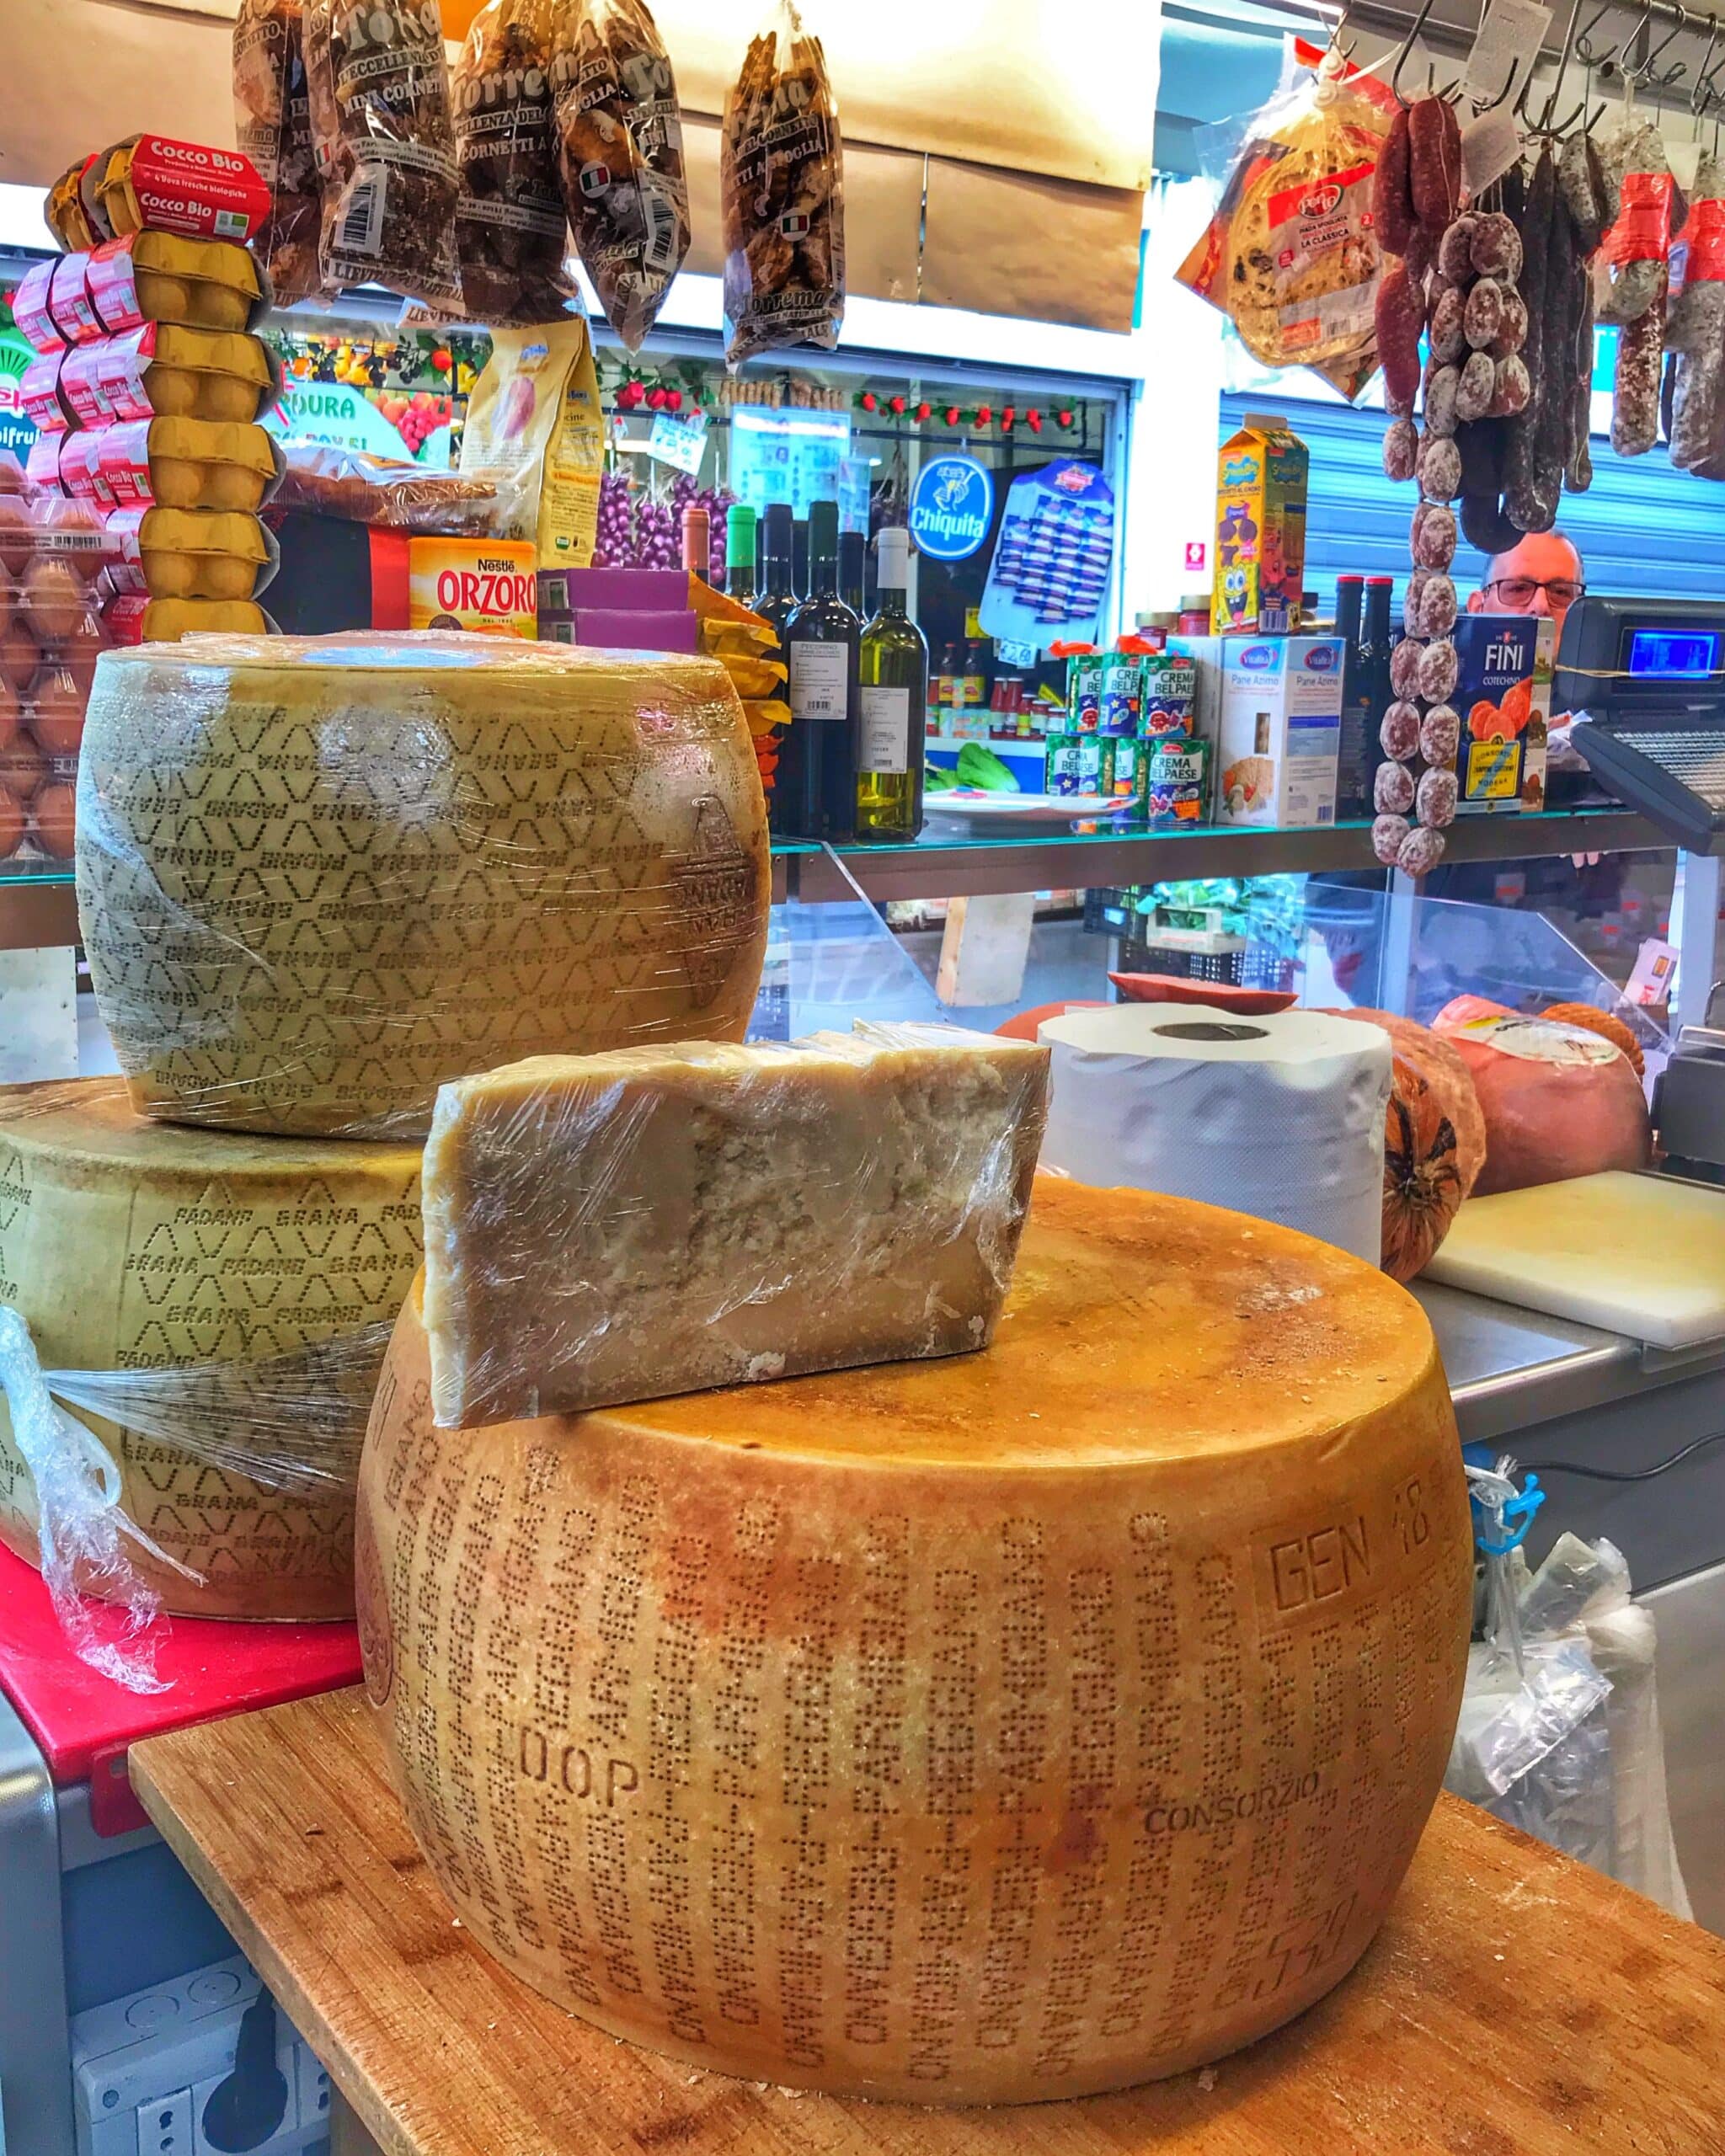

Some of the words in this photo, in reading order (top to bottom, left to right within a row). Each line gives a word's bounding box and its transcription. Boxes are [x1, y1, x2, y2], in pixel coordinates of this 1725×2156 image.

[150, 141, 208, 165] Cocco
[211, 152, 244, 173] Bio
[462, 137, 534, 163] CORNETTI
[517, 106, 544, 125] DEL
[140, 192, 184, 212] Cocco
[187, 200, 212, 218] Bio
[181, 178, 208, 192] fresche
[209, 184, 248, 200] biologiche
[1300, 239, 1311, 248] LA
[1311, 228, 1350, 246] CLASSICA
[911, 506, 985, 542] Chiquita
[437, 569, 537, 616] ORZORO
[1117, 669, 1139, 682] CRE
[1231, 675, 1252, 685] Pane
[1253, 675, 1279, 686] Azimo
[1296, 676, 1316, 686] Pane
[1317, 676, 1338, 686] Azimo
[1484, 644, 1524, 671] FINI
[1152, 757, 1191, 769] CREMA
[154, 847, 235, 867] GRANA
[275, 1207, 359, 1226] GRANA
[328, 1252, 414, 1273] GRANA
[166, 1305, 250, 1325] GRANA
[273, 1305, 363, 1325] PADANO
[175, 1492, 259, 1511] GRANA
[447, 1474, 505, 1705] REGGIANO
[1269, 1515, 1372, 1613] GEN
[649, 1535, 711, 1785] REGGIANO
[783, 1556, 841, 1808] REGGIANO
[852, 1512, 910, 1813] PARMIGIANO
[928, 1570, 978, 1813] REGGIANO
[999, 1518, 1049, 1812] PARMIGIANO
[1069, 1566, 1116, 1810] REGGIANO
[1129, 1513, 1180, 1806] PARMIGIANO
[1194, 1555, 1242, 1799] REGGIANO
[520, 1724, 640, 1807] DOP
[1144, 1770, 1320, 1834] CONSORZIO
[484, 1748, 546, 1951] REGGIANO
[649, 1811, 706, 2044] PARMIGIANO
[712, 1825, 759, 2025] REGGIANO
[780, 1838, 827, 2069] PARMIGIANO
[845, 1845, 899, 2045] REGGIANO
[909, 1846, 970, 2082] PARMIGIANO
[976, 1845, 1043, 2050] REGGIANO
[1033, 1842, 1108, 2078] PARMIGIANO
[1100, 1837, 1173, 2038] REGGIANO
